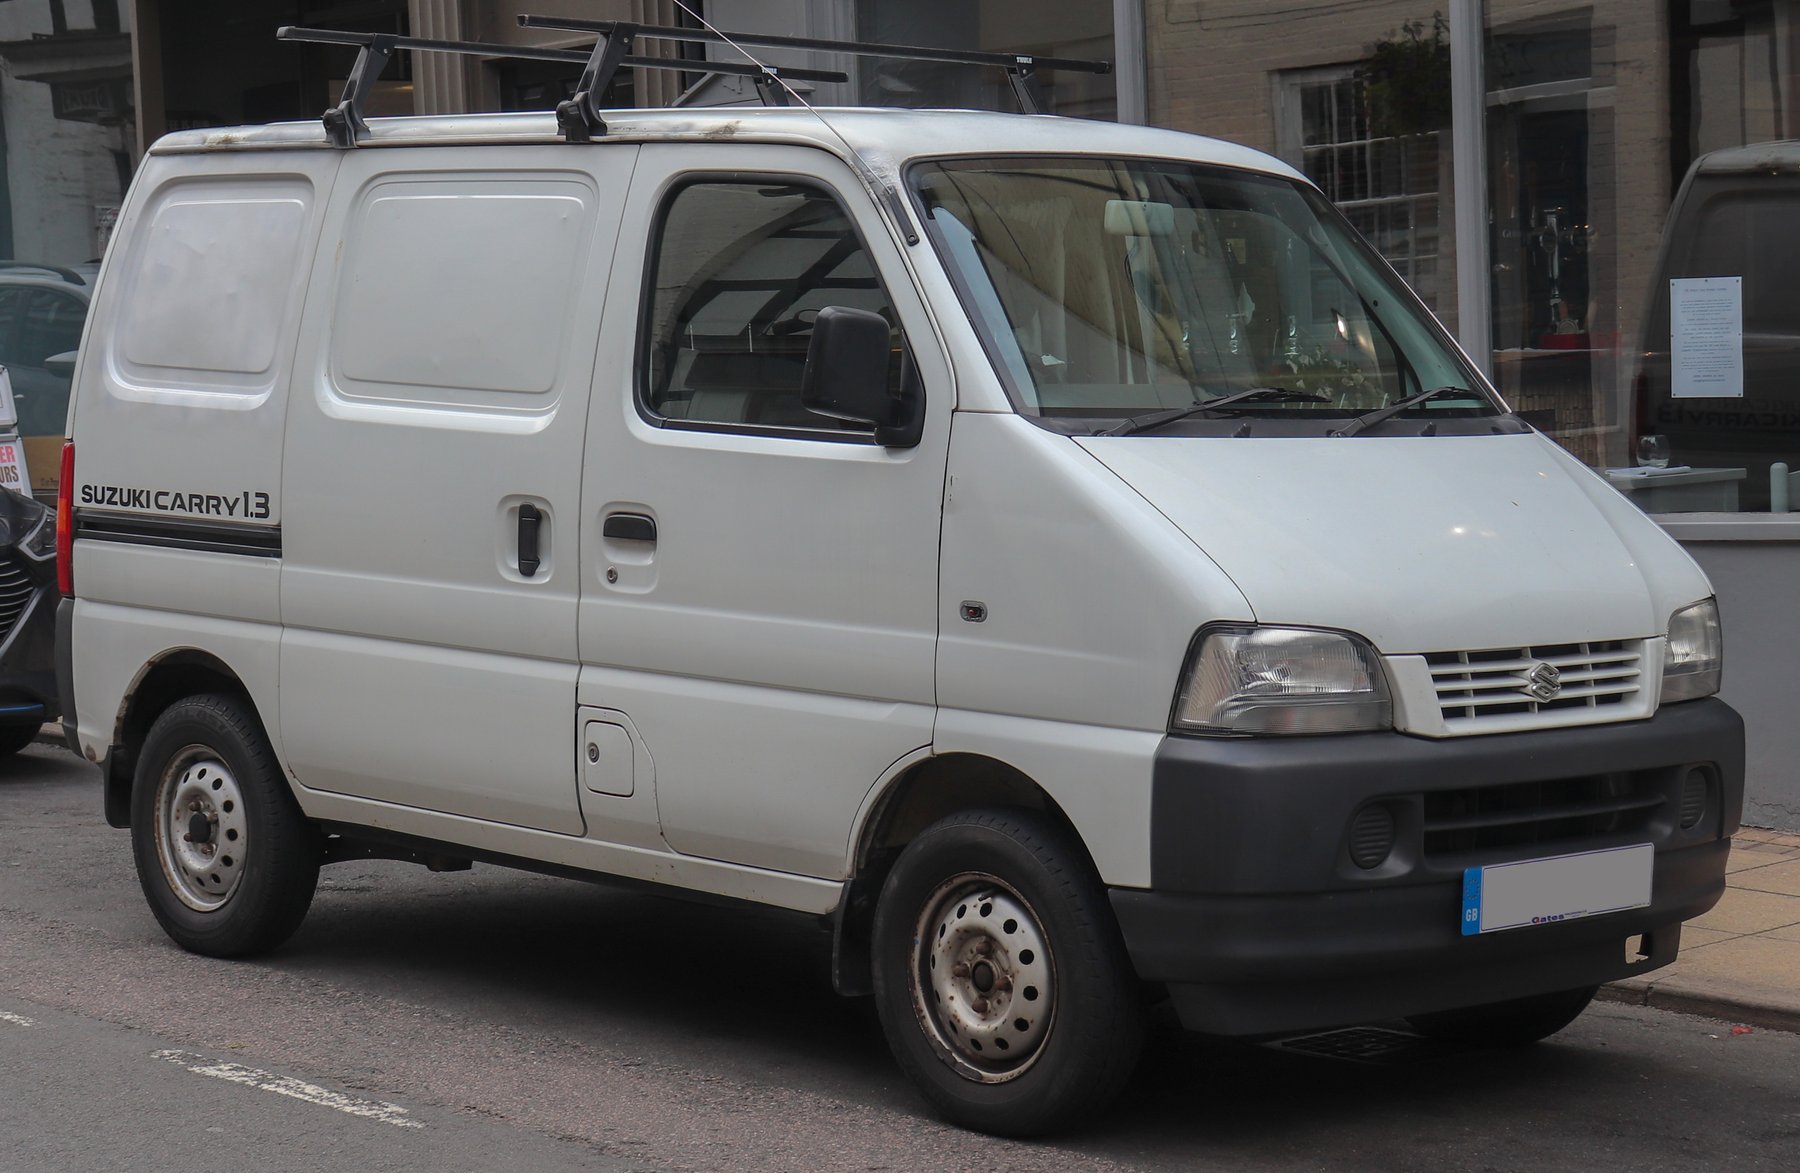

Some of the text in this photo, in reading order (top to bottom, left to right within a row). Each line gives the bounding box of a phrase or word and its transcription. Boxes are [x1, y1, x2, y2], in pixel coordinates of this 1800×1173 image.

[81, 484, 270, 519] SUZUKI CARRY 1.3
[1465, 908, 1478, 922] GB
[1531, 913, 1565, 925] Gates
